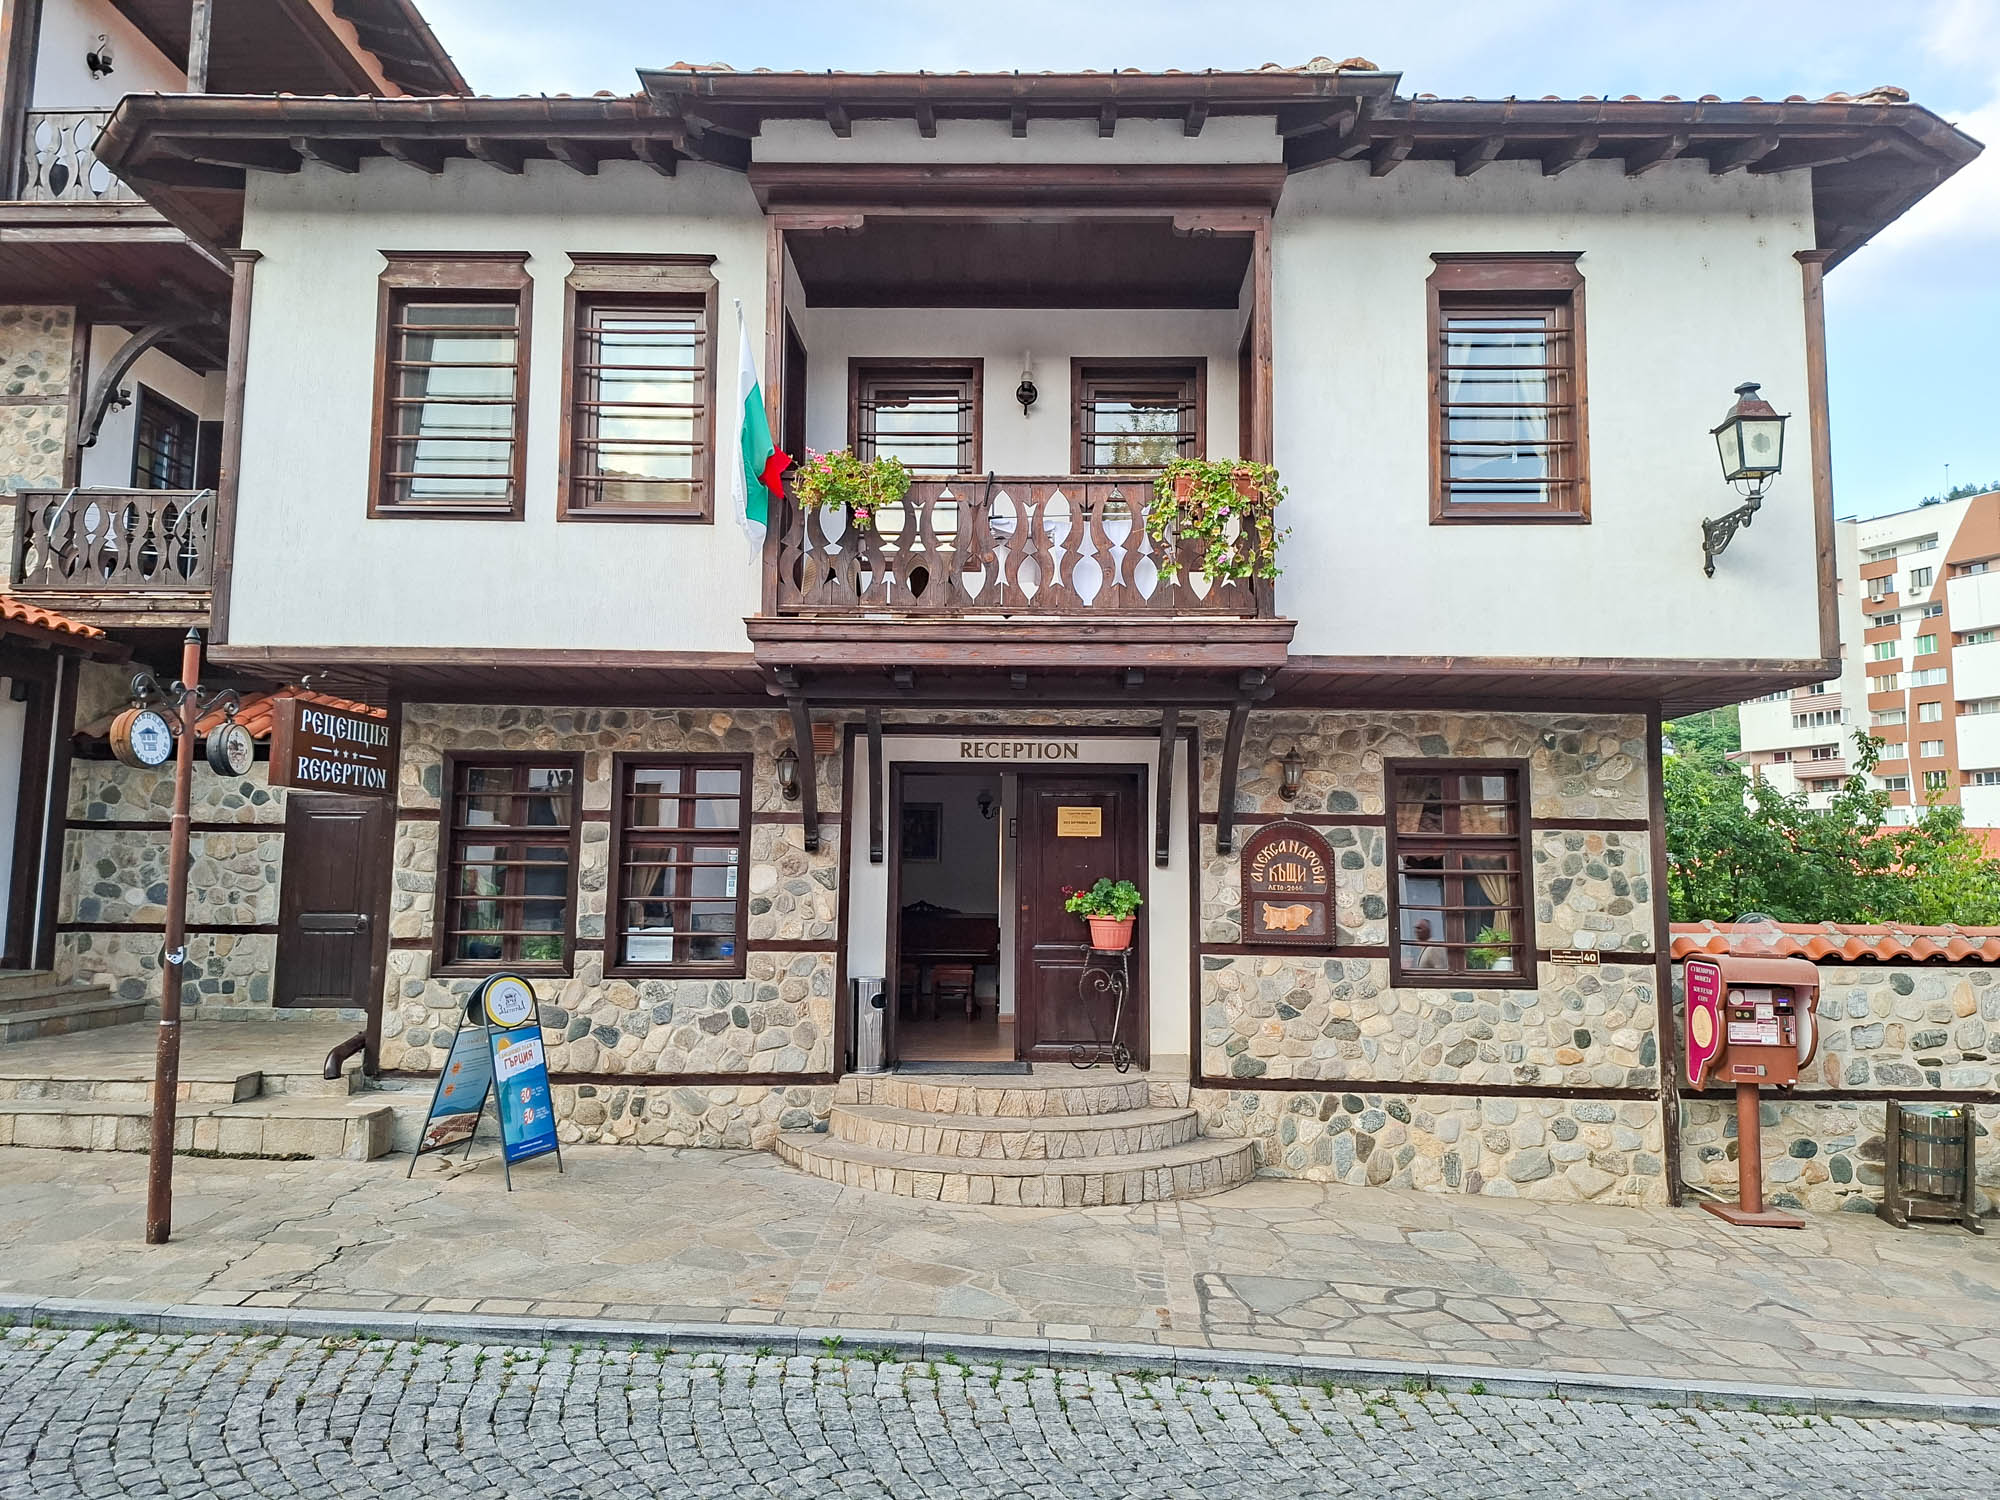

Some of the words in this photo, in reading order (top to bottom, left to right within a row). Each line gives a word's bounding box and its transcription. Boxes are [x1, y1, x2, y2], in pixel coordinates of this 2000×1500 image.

[300, 709, 390, 749] РЕЦЕПЦИЯ
[960, 741, 1079, 760] RECEPTION
[296, 756, 387, 789] RECEPTION
[1250, 840, 1326, 885] АЛЕКСАНДРОВИ
[1269, 862, 1306, 883] КЪЩИ
[1584, 953, 1597, 962] 40
[504, 1049, 534, 1070] ГЪРЦИЯ
